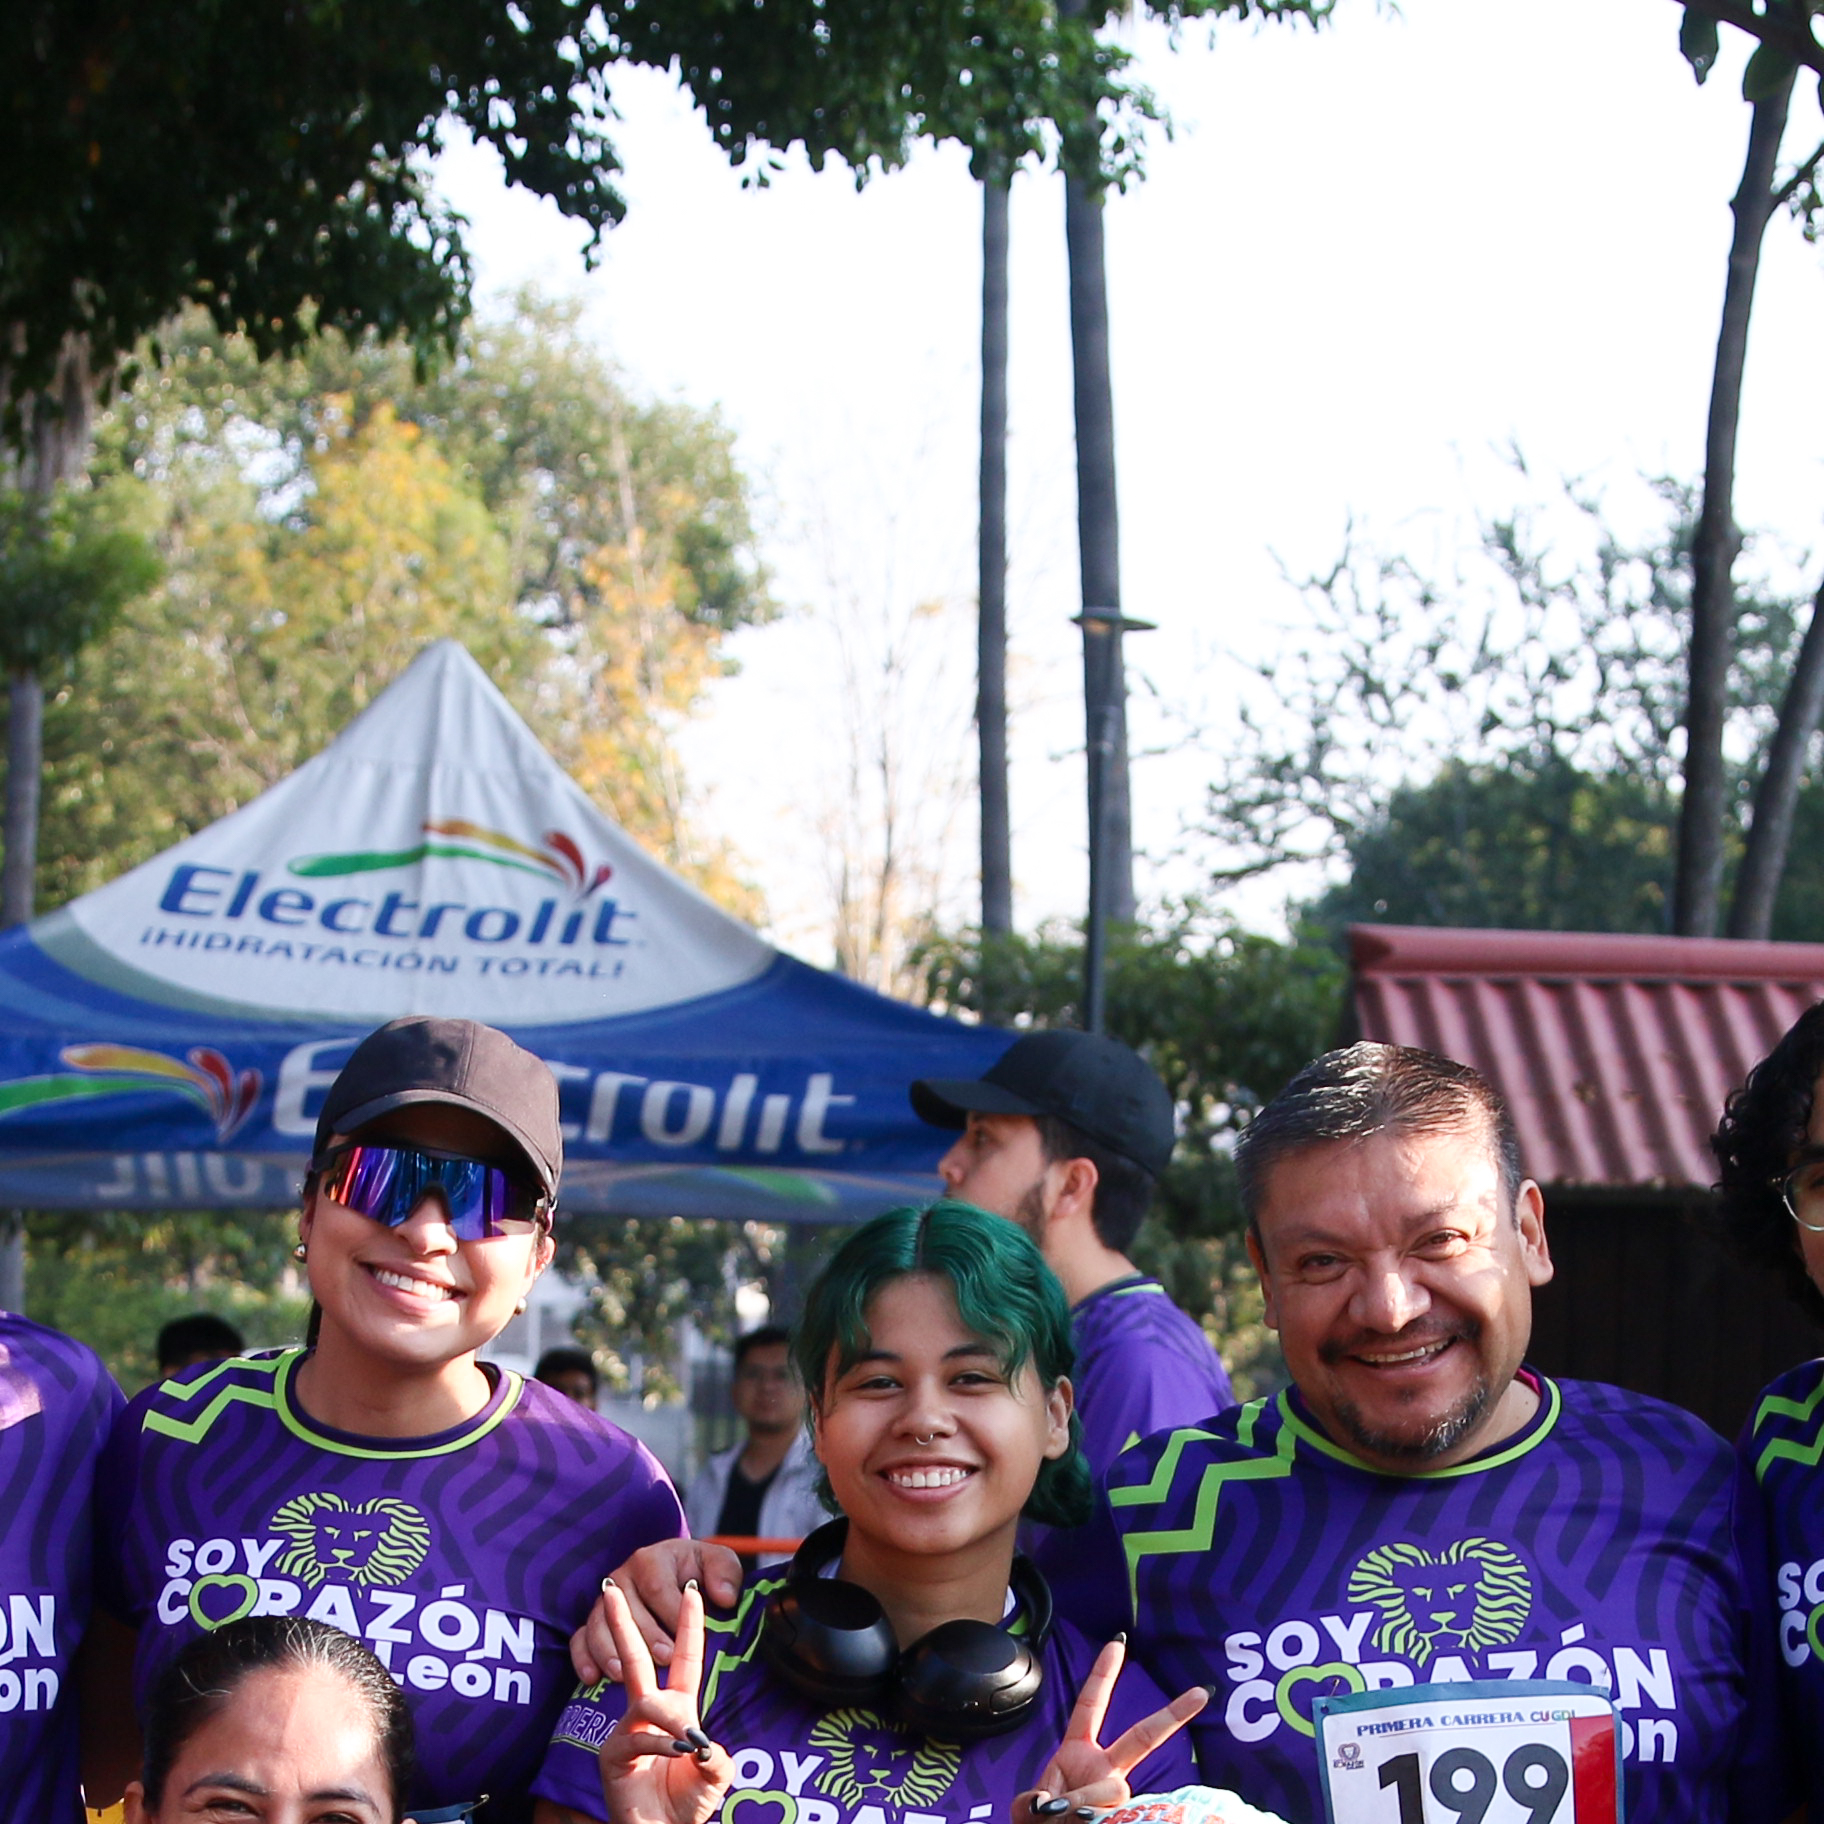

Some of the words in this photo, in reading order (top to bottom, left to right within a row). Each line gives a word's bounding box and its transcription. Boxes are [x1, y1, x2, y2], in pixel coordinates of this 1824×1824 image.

[159, 862, 639, 946] Electrolit
[165, 1538, 285, 1579] SOY
[376, 1641, 531, 1705] León
[1224, 1611, 1374, 1683] SOY
[1357, 1717, 1435, 1737] PRIMERA
[1441, 1710, 1525, 1727] CARRERA
[728, 1749, 825, 1794] OY
